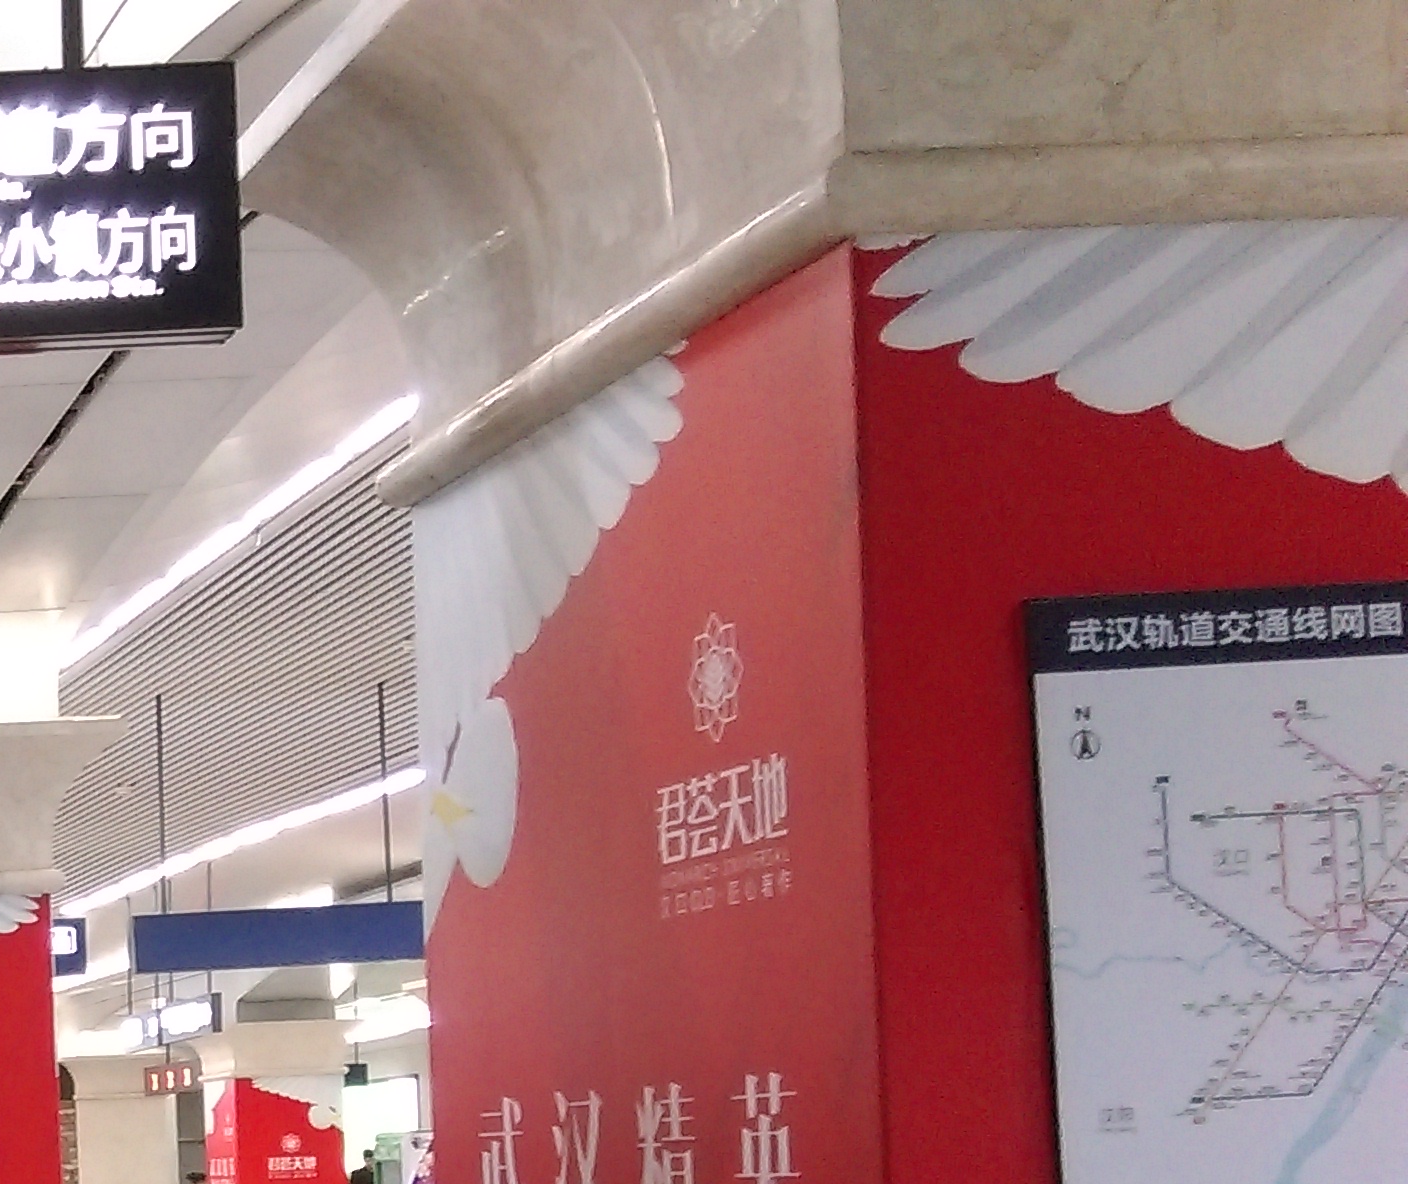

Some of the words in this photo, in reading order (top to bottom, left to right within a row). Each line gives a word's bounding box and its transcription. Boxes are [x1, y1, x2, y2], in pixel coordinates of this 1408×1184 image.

[1067, 602, 1404, 653] 武汉轨道交通线网图
[656, 753, 790, 865] 君荟天地
